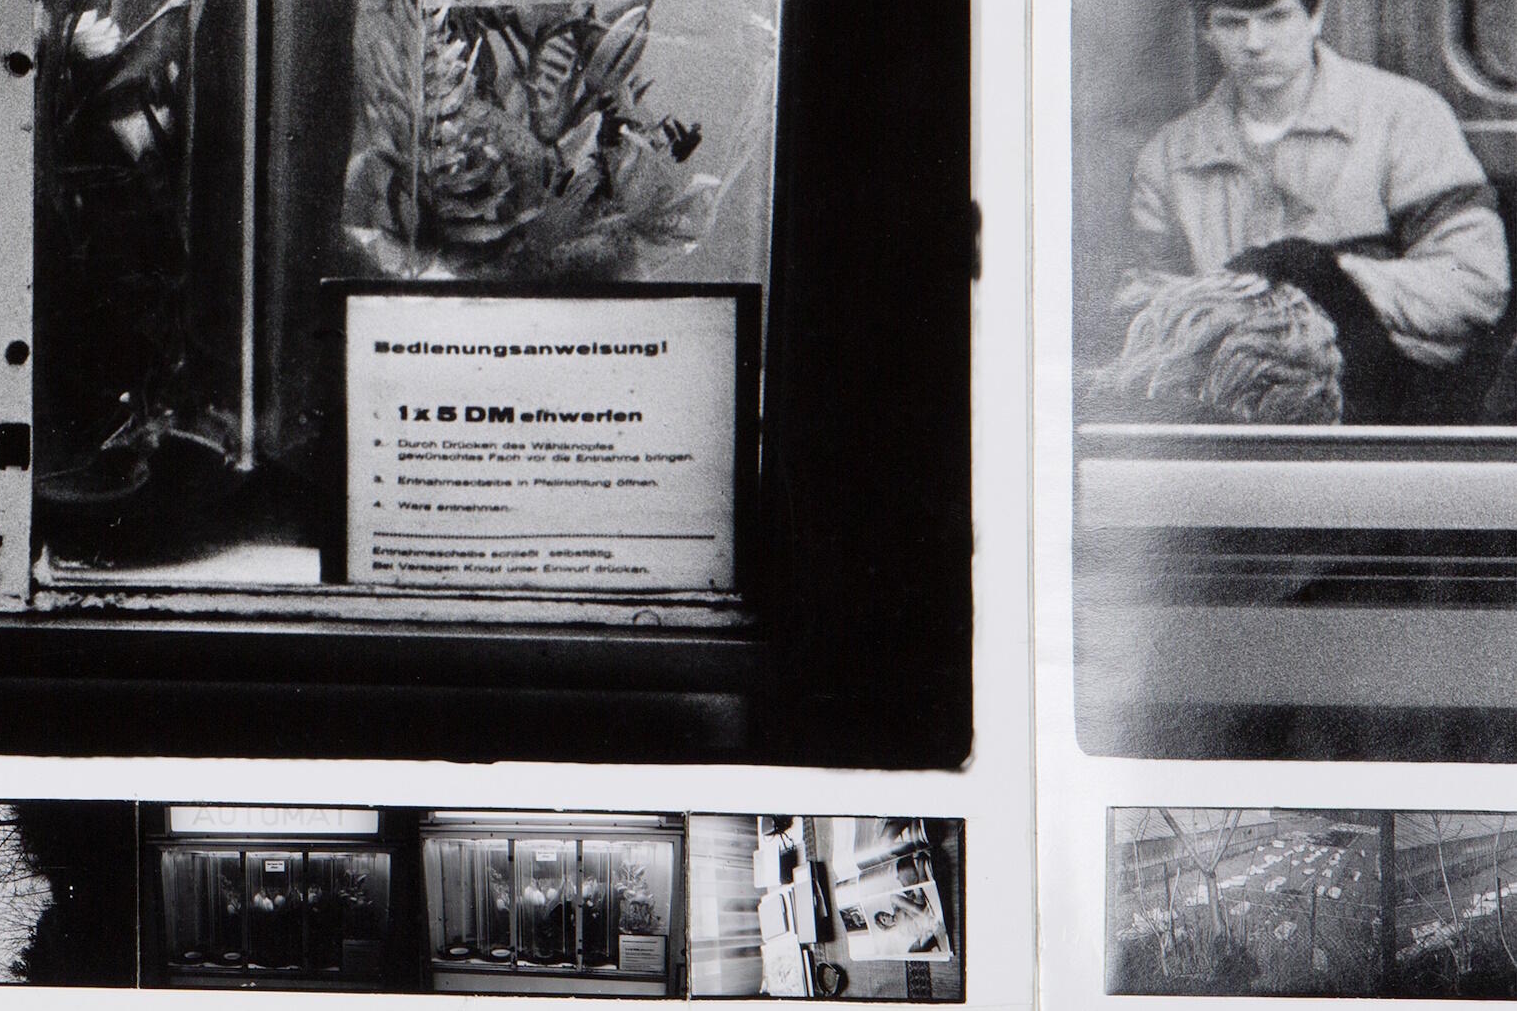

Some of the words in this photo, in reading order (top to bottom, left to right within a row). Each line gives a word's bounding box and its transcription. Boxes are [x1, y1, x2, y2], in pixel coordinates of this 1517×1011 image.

[374, 341, 668, 358] Bedienungsanweisung!
[465, 406, 515, 423] DM
[520, 409, 643, 423] einwerfen
[397, 439, 438, 450] Durch
[192, 808, 344, 826] AUTOMAT
